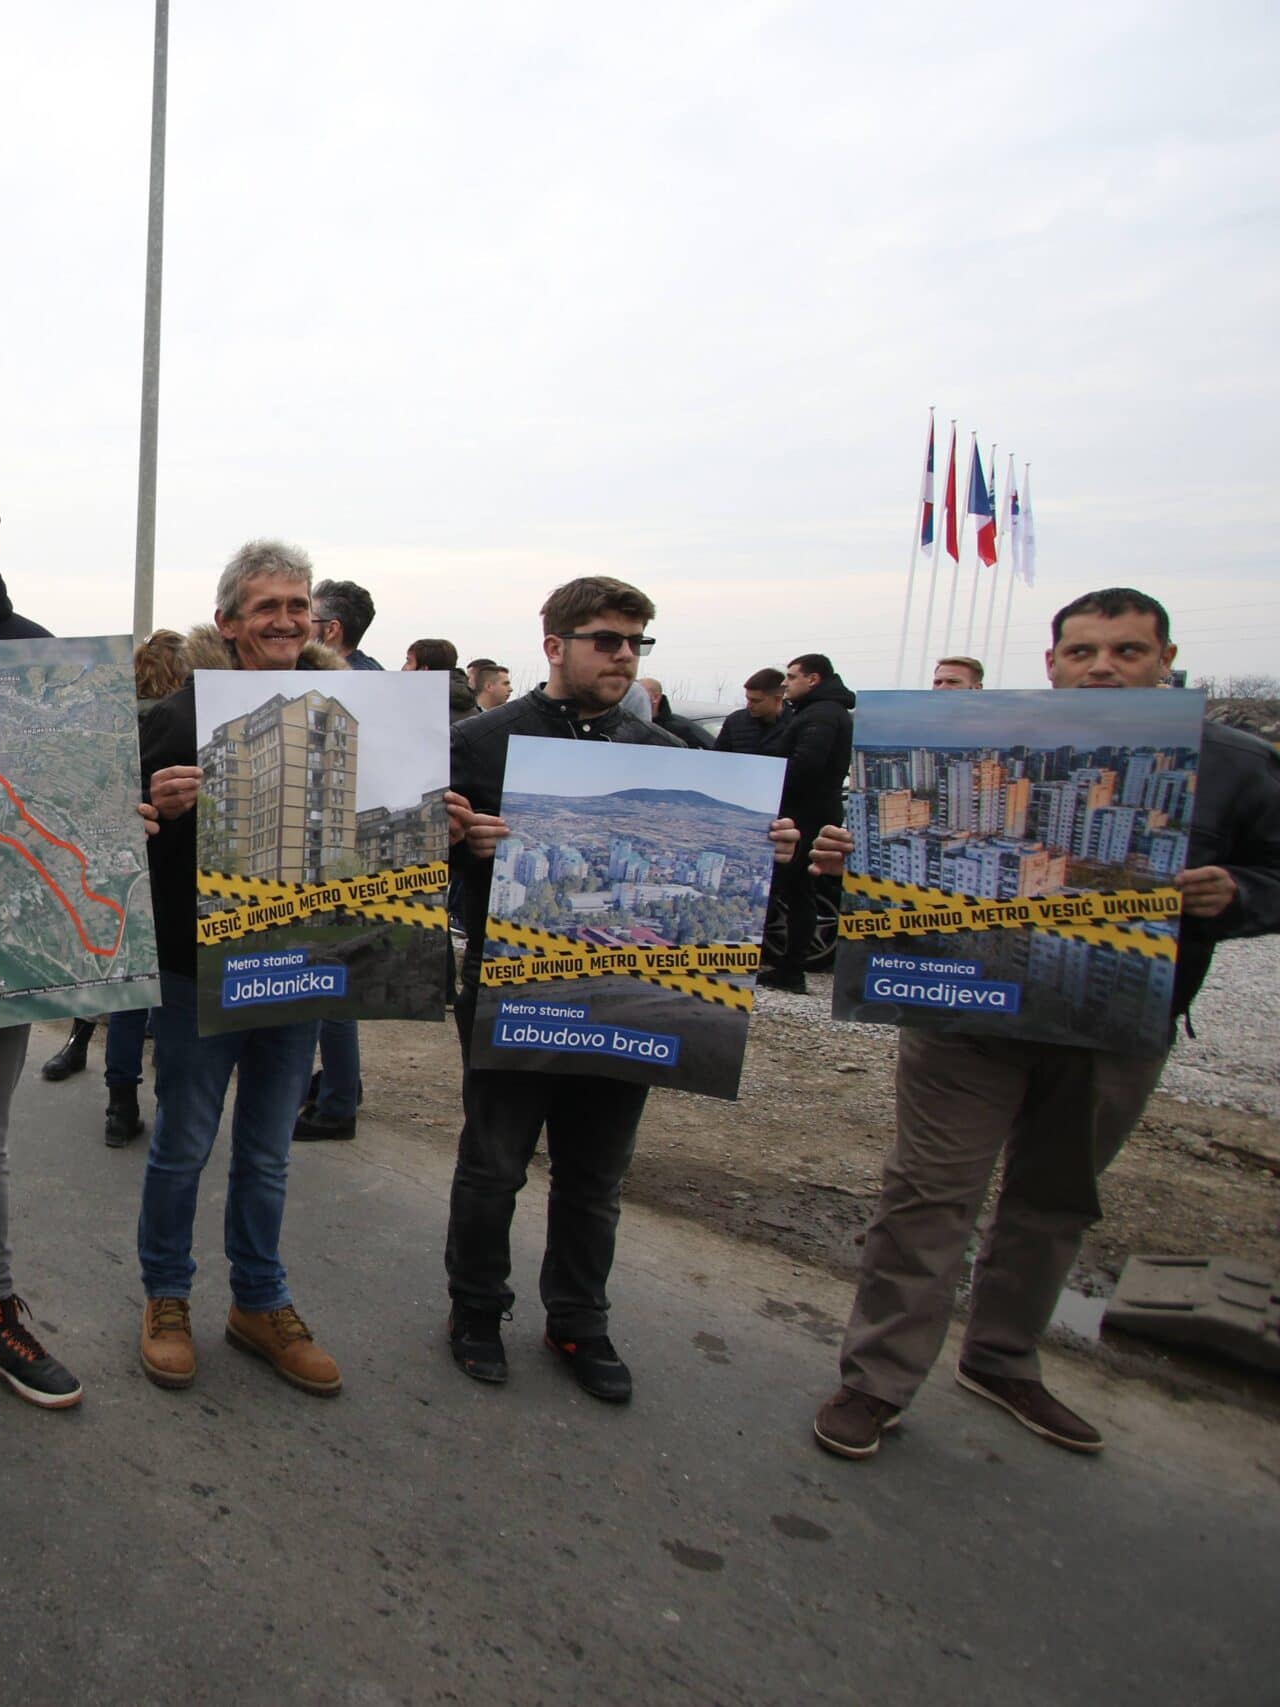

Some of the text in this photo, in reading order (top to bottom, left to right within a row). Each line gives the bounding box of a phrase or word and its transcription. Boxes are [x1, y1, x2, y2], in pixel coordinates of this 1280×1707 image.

[201, 869, 447, 939] VESIĆ UKINUO METRO VESIĆ UKINUO
[844, 896, 1178, 933] VESIĆ UKINUO METRO VESIĆ UKINUO
[227, 952, 303, 972] Metro stanica
[485, 951, 758, 980] VESIĆ UKINUO METRO VESIĆ UKINUO
[872, 957, 976, 975] Metro stanica
[230, 972, 334, 1002] Jablanička
[874, 978, 1006, 1007] Gandijeva
[501, 1003, 585, 1019] Metro stanica
[501, 1024, 669, 1058] Labudovo brdo
